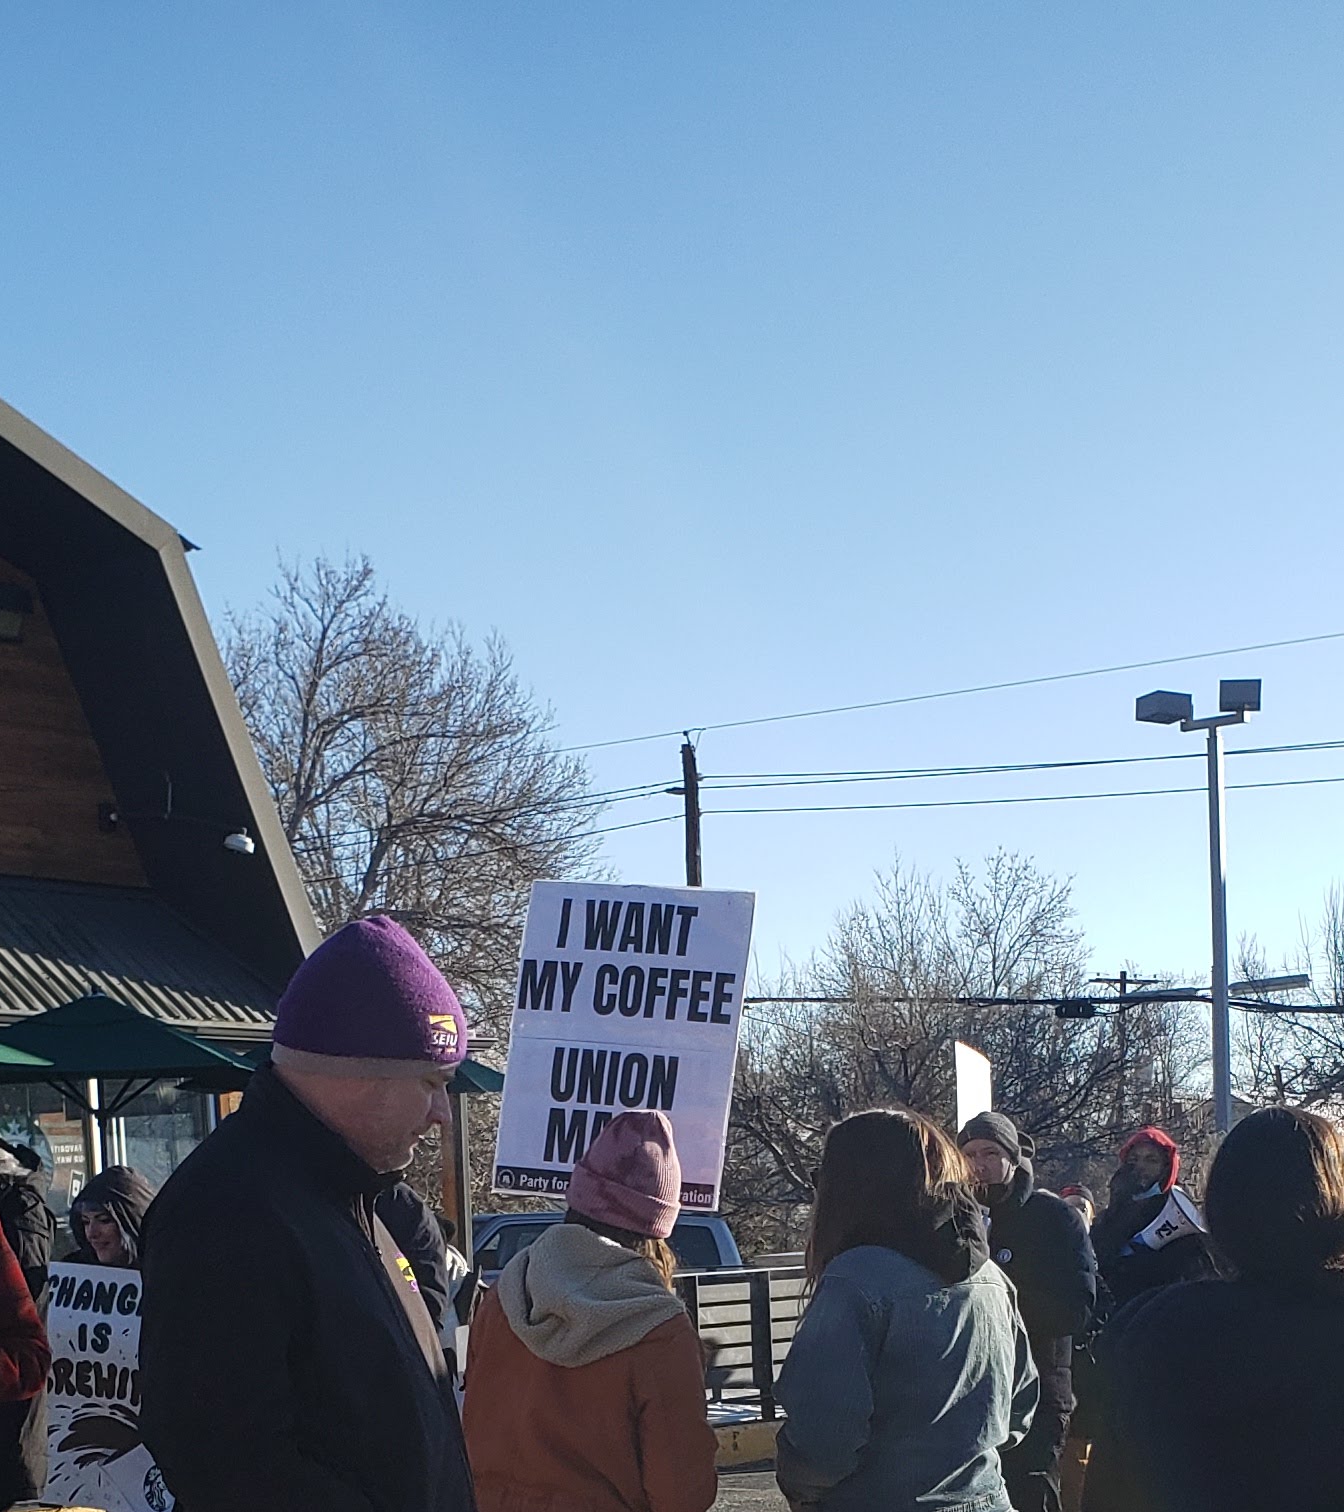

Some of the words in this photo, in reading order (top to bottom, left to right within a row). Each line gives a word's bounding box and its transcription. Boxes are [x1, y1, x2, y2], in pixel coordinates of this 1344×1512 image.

[557, 898, 573, 948] I
[584, 900, 699, 956] WANT
[517, 959, 583, 1012] MY
[593, 963, 736, 1025] COFFEE
[432, 1033, 458, 1046] SEIU
[551, 1047, 679, 1111] UNION
[519, 1174, 549, 1190] Party
[551, 1176, 570, 1190] for
[48, 1274, 141, 1316] CHANG
[78, 1322, 112, 1354] IS
